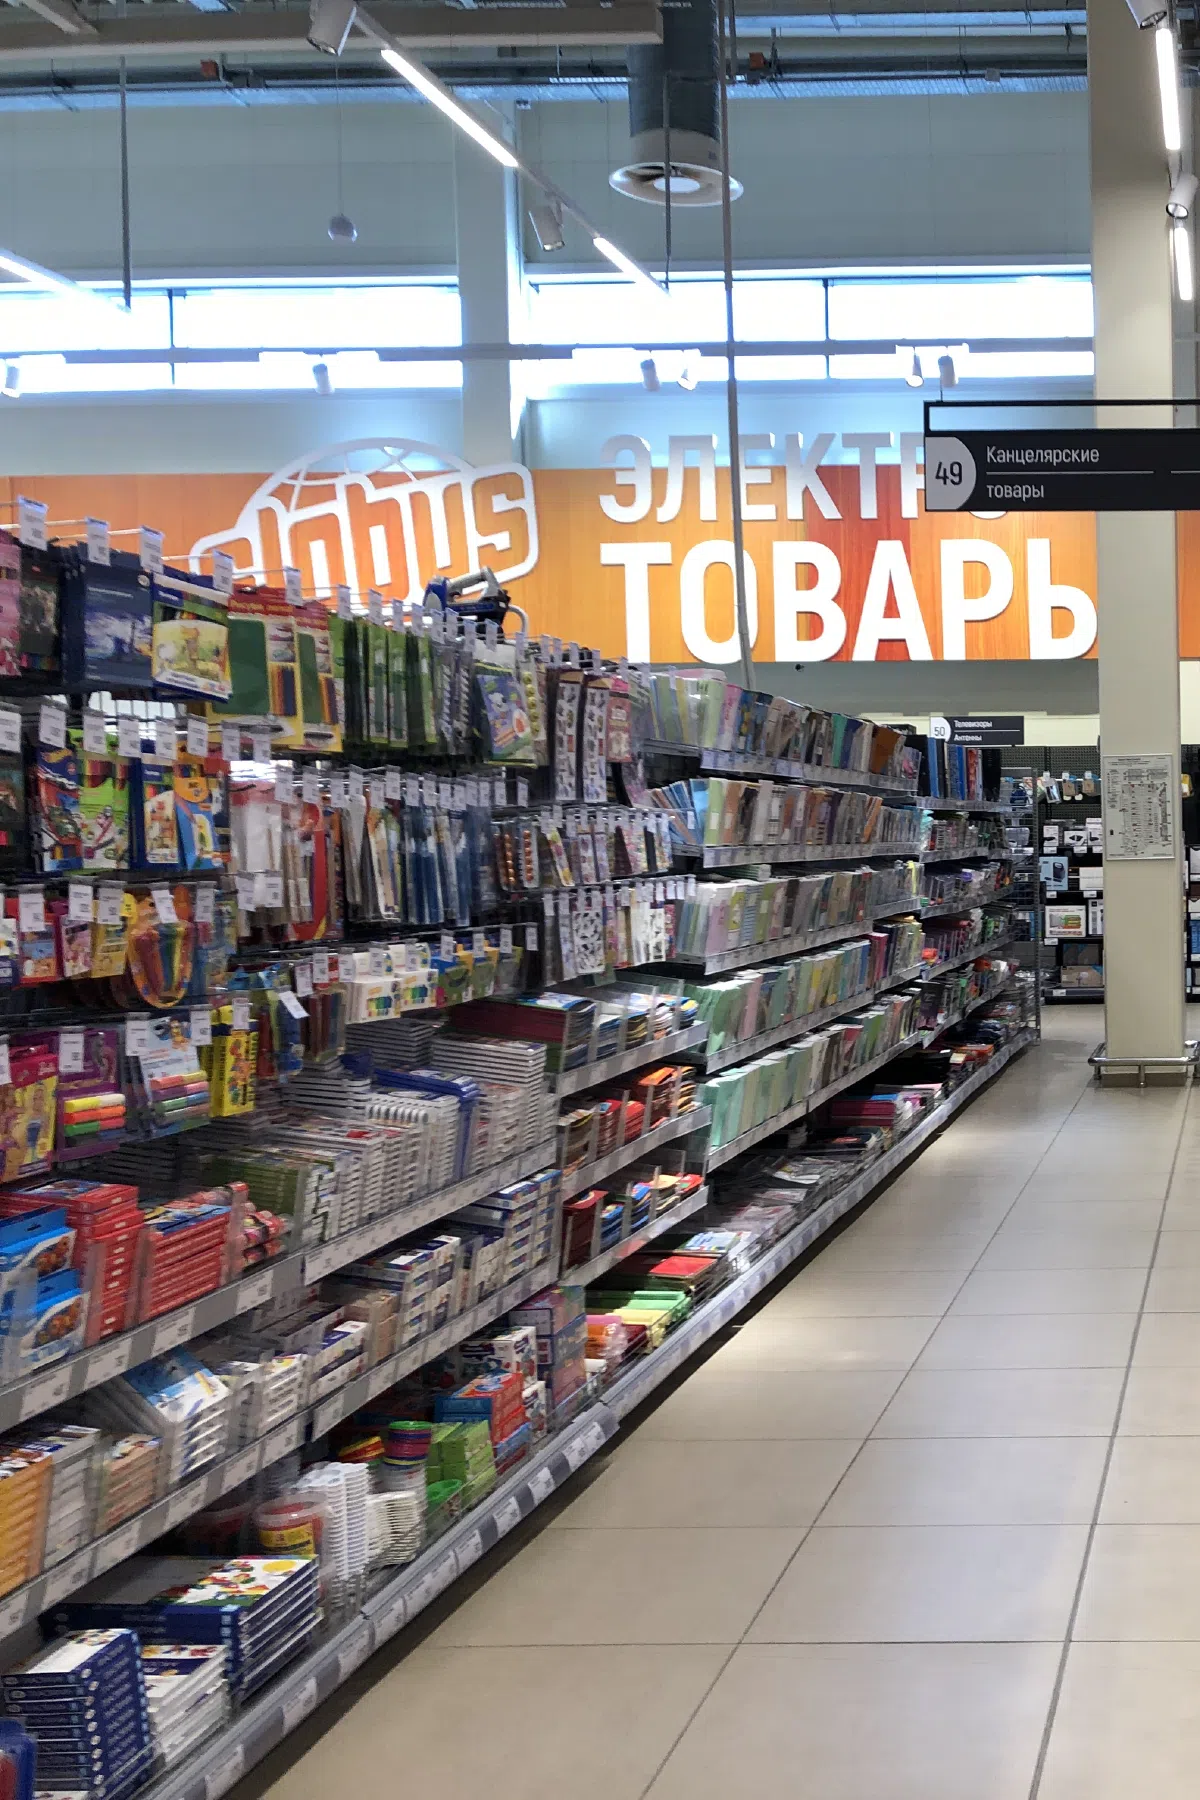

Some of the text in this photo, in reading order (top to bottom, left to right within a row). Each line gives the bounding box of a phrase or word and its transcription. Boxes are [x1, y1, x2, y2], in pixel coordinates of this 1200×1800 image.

[986, 445, 1100, 467] Канцелярские
[935, 460, 963, 486] 49
[986, 484, 1045, 502] товары
[954, 719, 993, 729] Телевизоры
[934, 726, 946, 737] 50
[954, 733, 983, 742] Антенны
